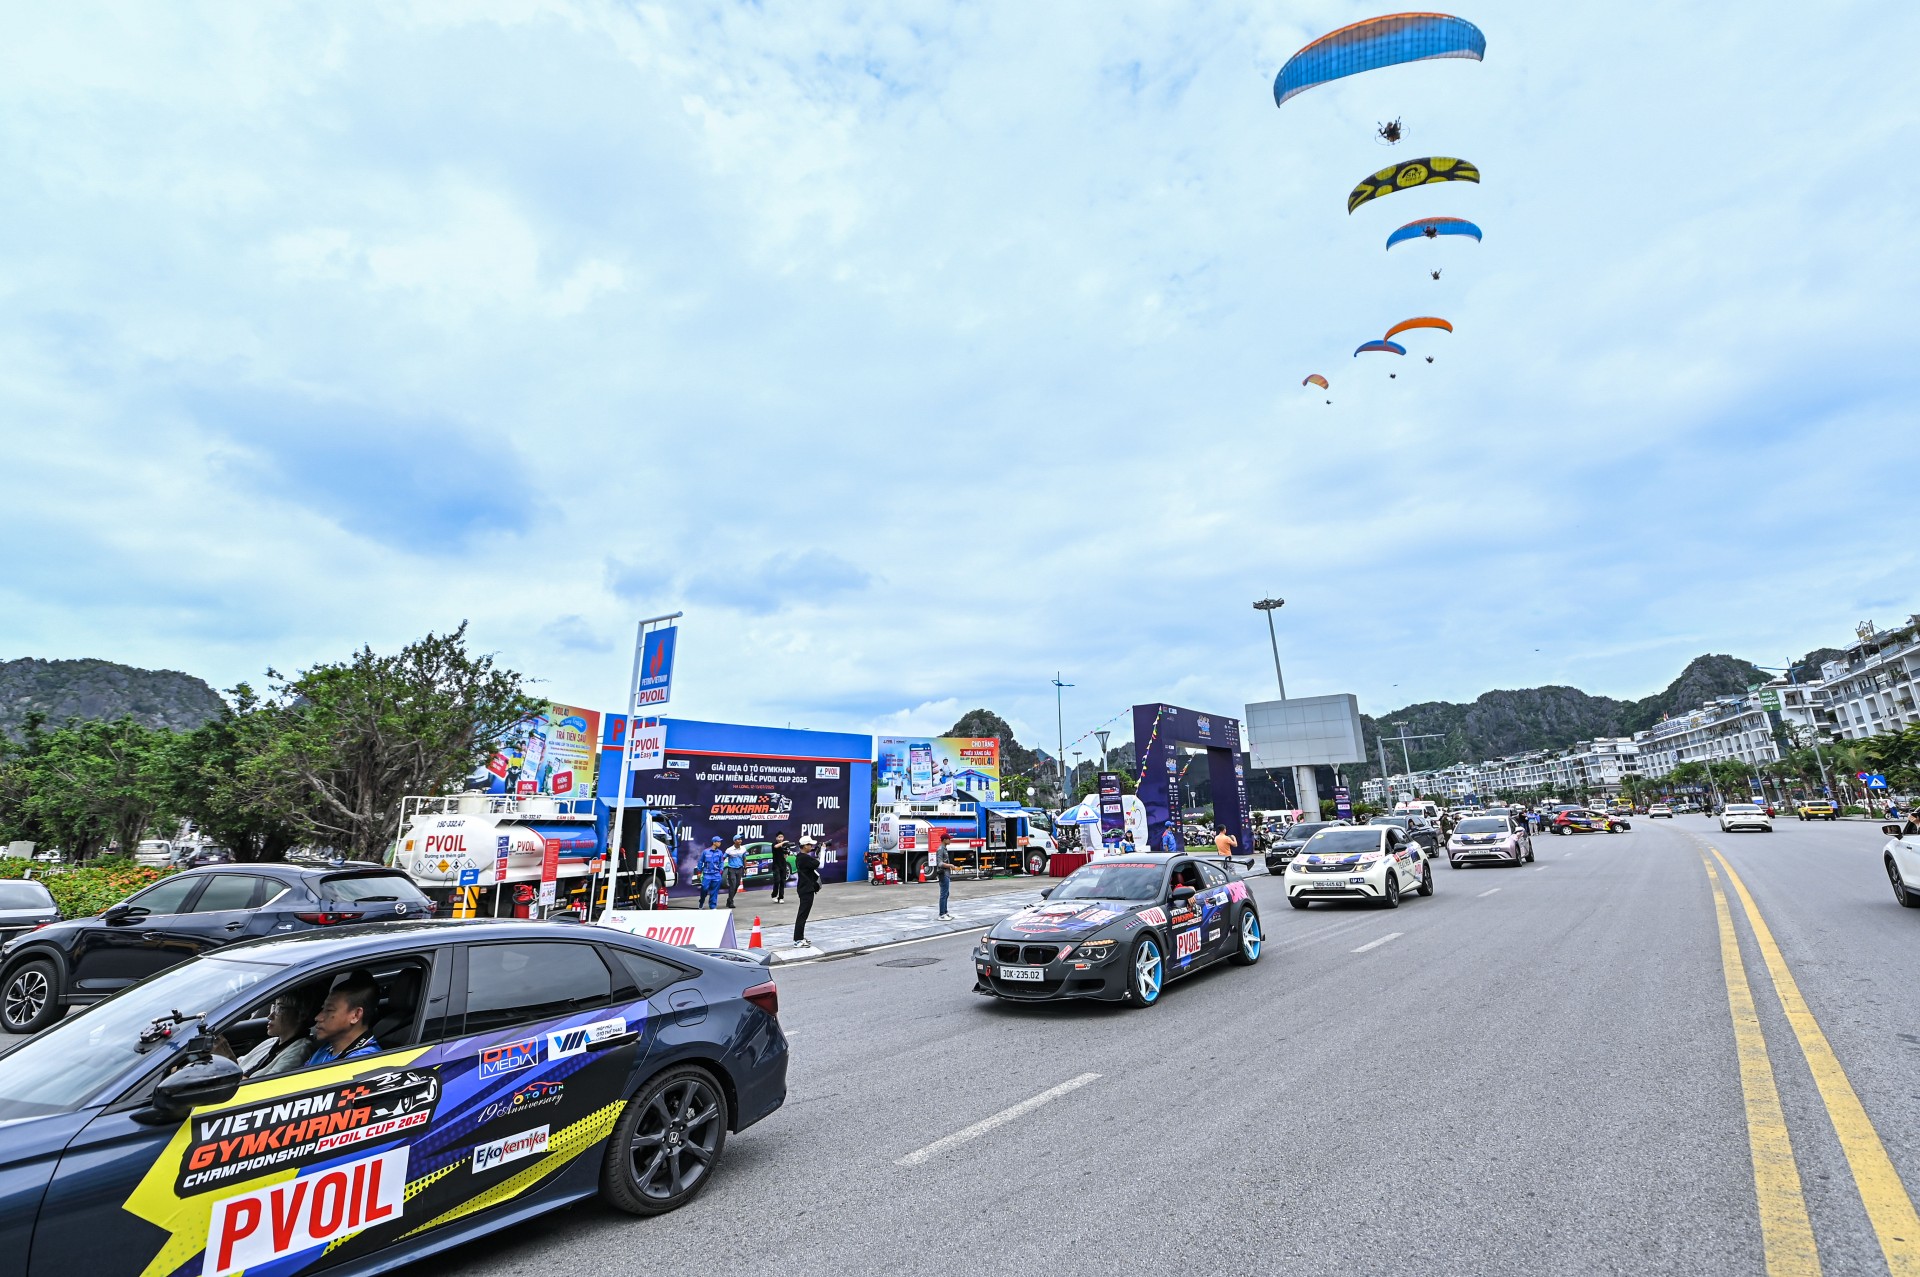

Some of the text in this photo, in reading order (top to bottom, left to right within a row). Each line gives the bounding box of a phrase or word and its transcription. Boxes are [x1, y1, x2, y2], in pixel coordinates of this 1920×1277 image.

[640, 688, 665, 703] PVOIL
[635, 737, 660, 751] PVOIL
[640, 751, 652, 759] Easy
[711, 761, 796, 774] GIẢI ĐUA Ô TÔ GYMKHANA
[825, 767, 838, 776] PVOIL
[695, 771, 706, 781] VÔ
[707, 774, 725, 782] ĐỊCH
[725, 772, 744, 782] MIỀN
[744, 772, 758, 782] BẮC
[758, 775, 778, 783] PVOIL
[714, 795, 757, 803] VIETNAM
[817, 796, 840, 809] PVOIL
[711, 804, 770, 813] GYMKHANA
[801, 823, 825, 837] PVOIL
[425, 835, 467, 852] PVOIL
[516, 840, 536, 852] PVOIL
[1139, 905, 1166, 925] PVOIL
[1178, 930, 1200, 957] PVOIL
[1002, 969, 1040, 980] 30K-235.02
[484, 1040, 534, 1063] OTV
[484, 1053, 535, 1075] MEDIA
[513, 1084, 564, 1105] OTOFUN
[497, 1093, 564, 1118] Anniversary
[200, 1092, 335, 1142] VIETNAM
[188, 1106, 371, 1171] GYMKHANA
[183, 1111, 428, 1188] CHAMPIONSHIP PVOIL CUP 2025
[476, 1130, 546, 1169] Ekokemika
[216, 1158, 393, 1273] PVOIL
